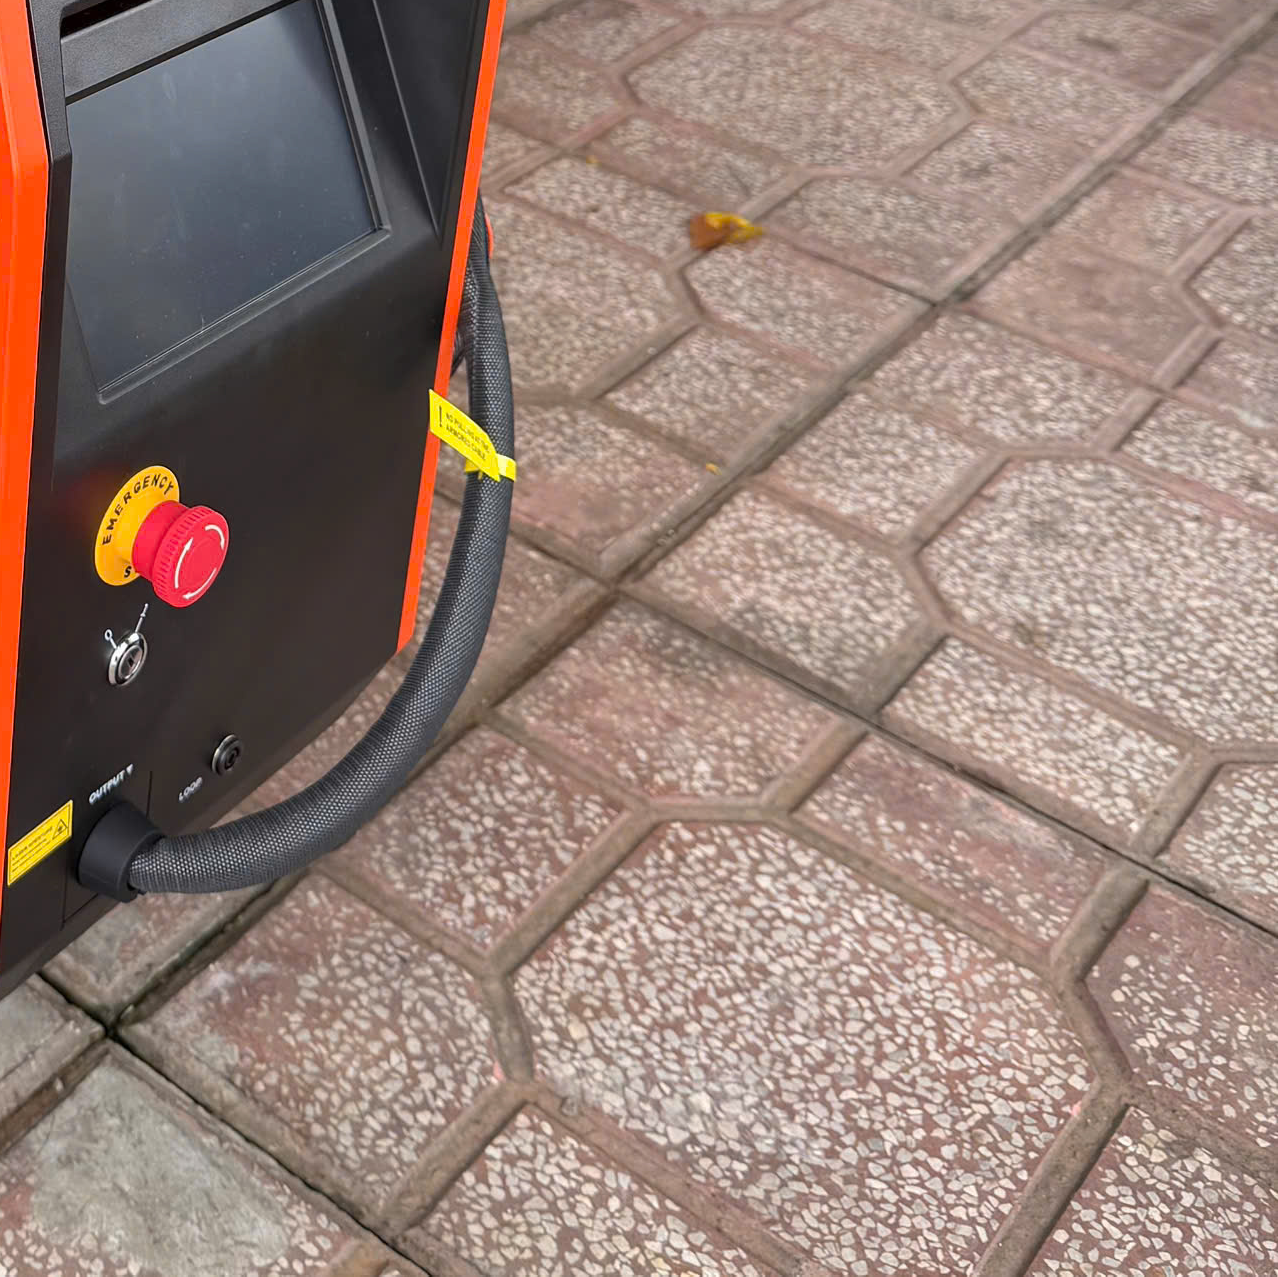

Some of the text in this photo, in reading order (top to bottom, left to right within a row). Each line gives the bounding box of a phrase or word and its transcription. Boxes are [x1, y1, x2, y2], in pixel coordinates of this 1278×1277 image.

[102, 473, 174, 545] EMERGENCY
[89, 769, 125, 804] OUTPUT
[178, 776, 202, 802] LOOP
